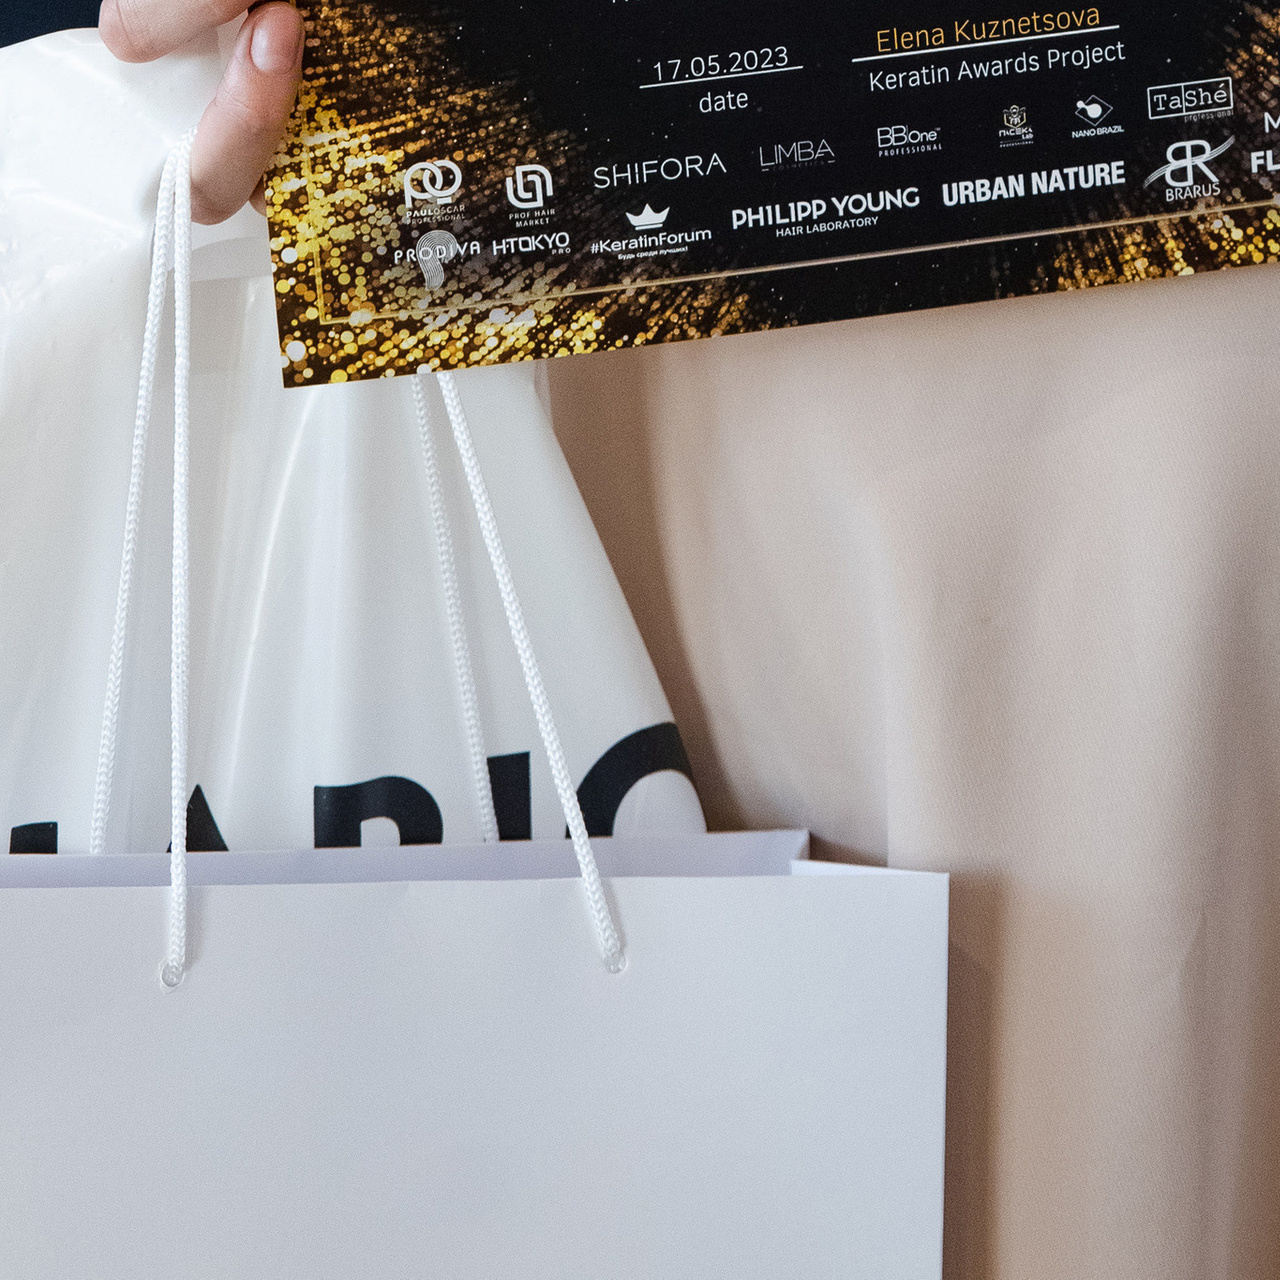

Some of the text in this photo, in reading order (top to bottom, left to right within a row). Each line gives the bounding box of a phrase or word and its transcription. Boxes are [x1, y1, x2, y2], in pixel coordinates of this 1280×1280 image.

[876, 5, 1101, 53] Elena Kuznetsova
[653, 45, 789, 82] 17.05.2023
[868, 42, 1126, 92] Keratin Awards Project
[699, 90, 749, 114] date
[1154, 82, 1228, 112] TaShé
[1071, 125, 1125, 138] NANO BRAZIL
[759, 139, 835, 167] LIMBA
[878, 143, 942, 157] PROFESSIONAL
[593, 152, 727, 189] SHIFORA
[942, 160, 1126, 207] URBAN NATURE
[1165, 182, 1221, 202] BRARUS
[509, 208, 556, 220] PROF HAIR
[732, 187, 920, 230] PHILIPP YOUNG
[516, 217, 550, 228] MARKET
[776, 216, 878, 237] HAIR LABORATORY
[394, 241, 480, 264] PRODIVA
[552, 247, 571, 255] PRO
[590, 229, 712, 254] #KeratinForum
